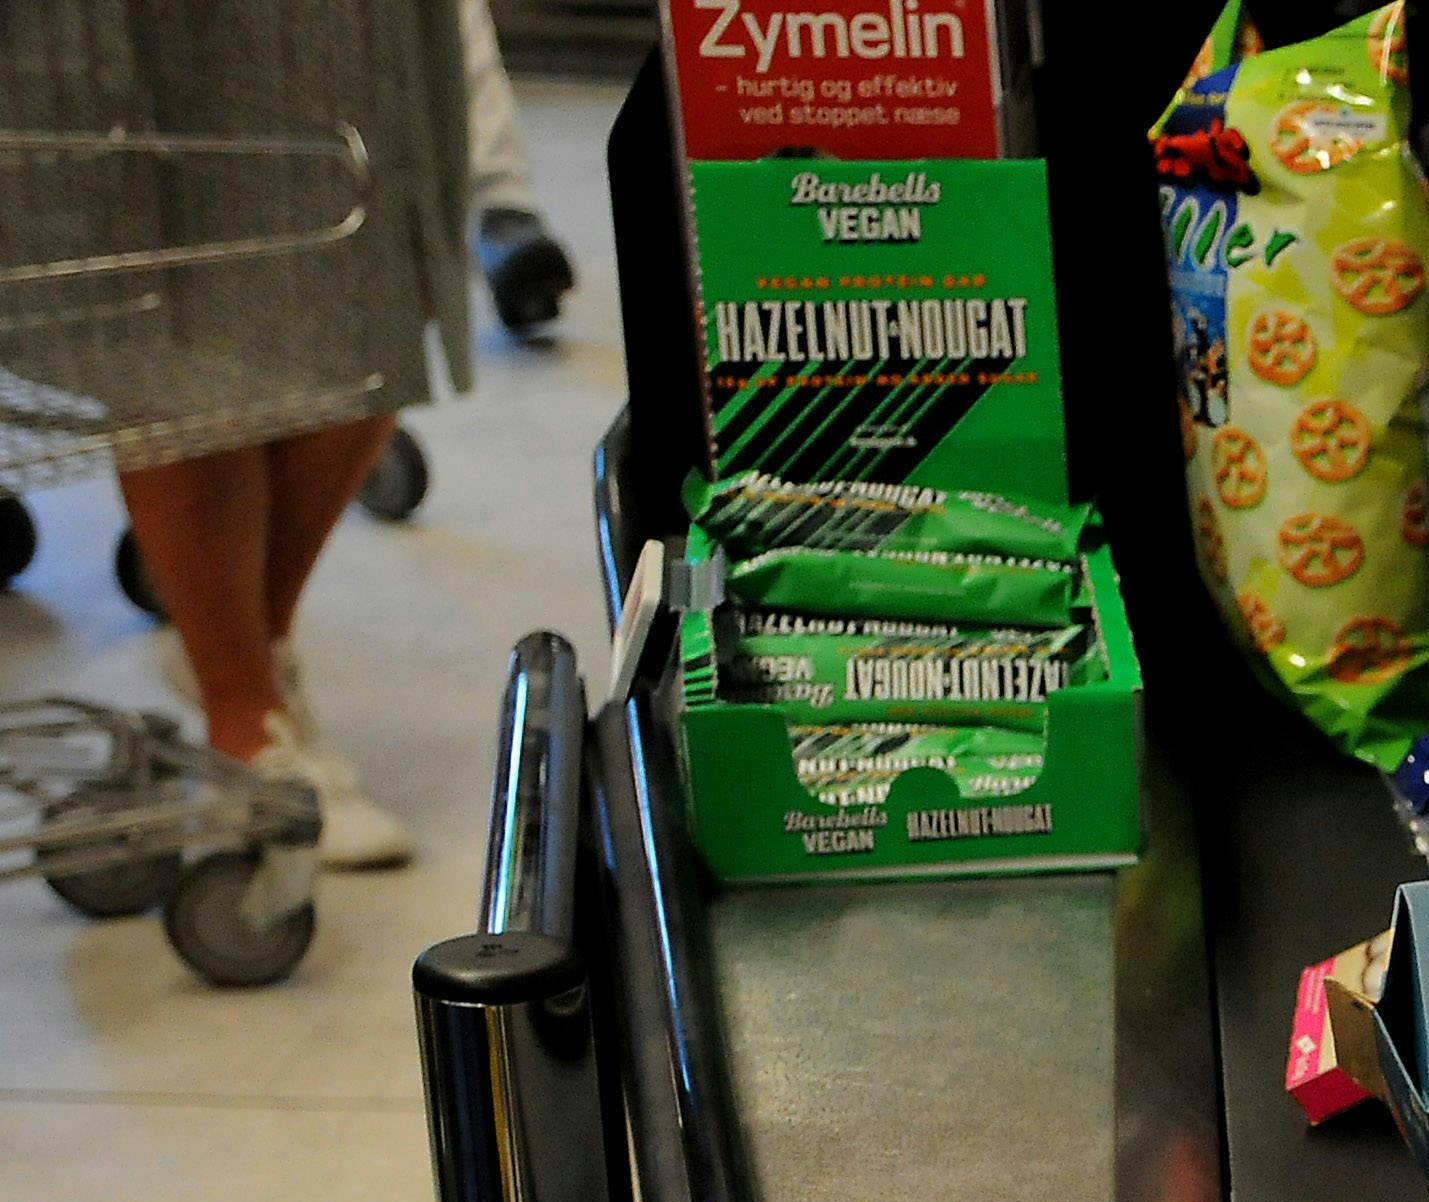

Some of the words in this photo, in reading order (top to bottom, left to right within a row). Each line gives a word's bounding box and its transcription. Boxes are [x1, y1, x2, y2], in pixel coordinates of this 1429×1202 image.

[695, 0, 965, 73] Zymelin
[736, 75, 815, 100] hurtig
[820, 80, 851, 101] og
[858, 74, 957, 98] effektiv
[740, 103, 783, 124] ved
[789, 104, 889, 127] stoppet
[790, 172, 942, 206] Barebells
[818, 207, 922, 241] VEGAN
[784, 805, 888, 832] Barebells
[802, 828, 875, 856] VEGAN
